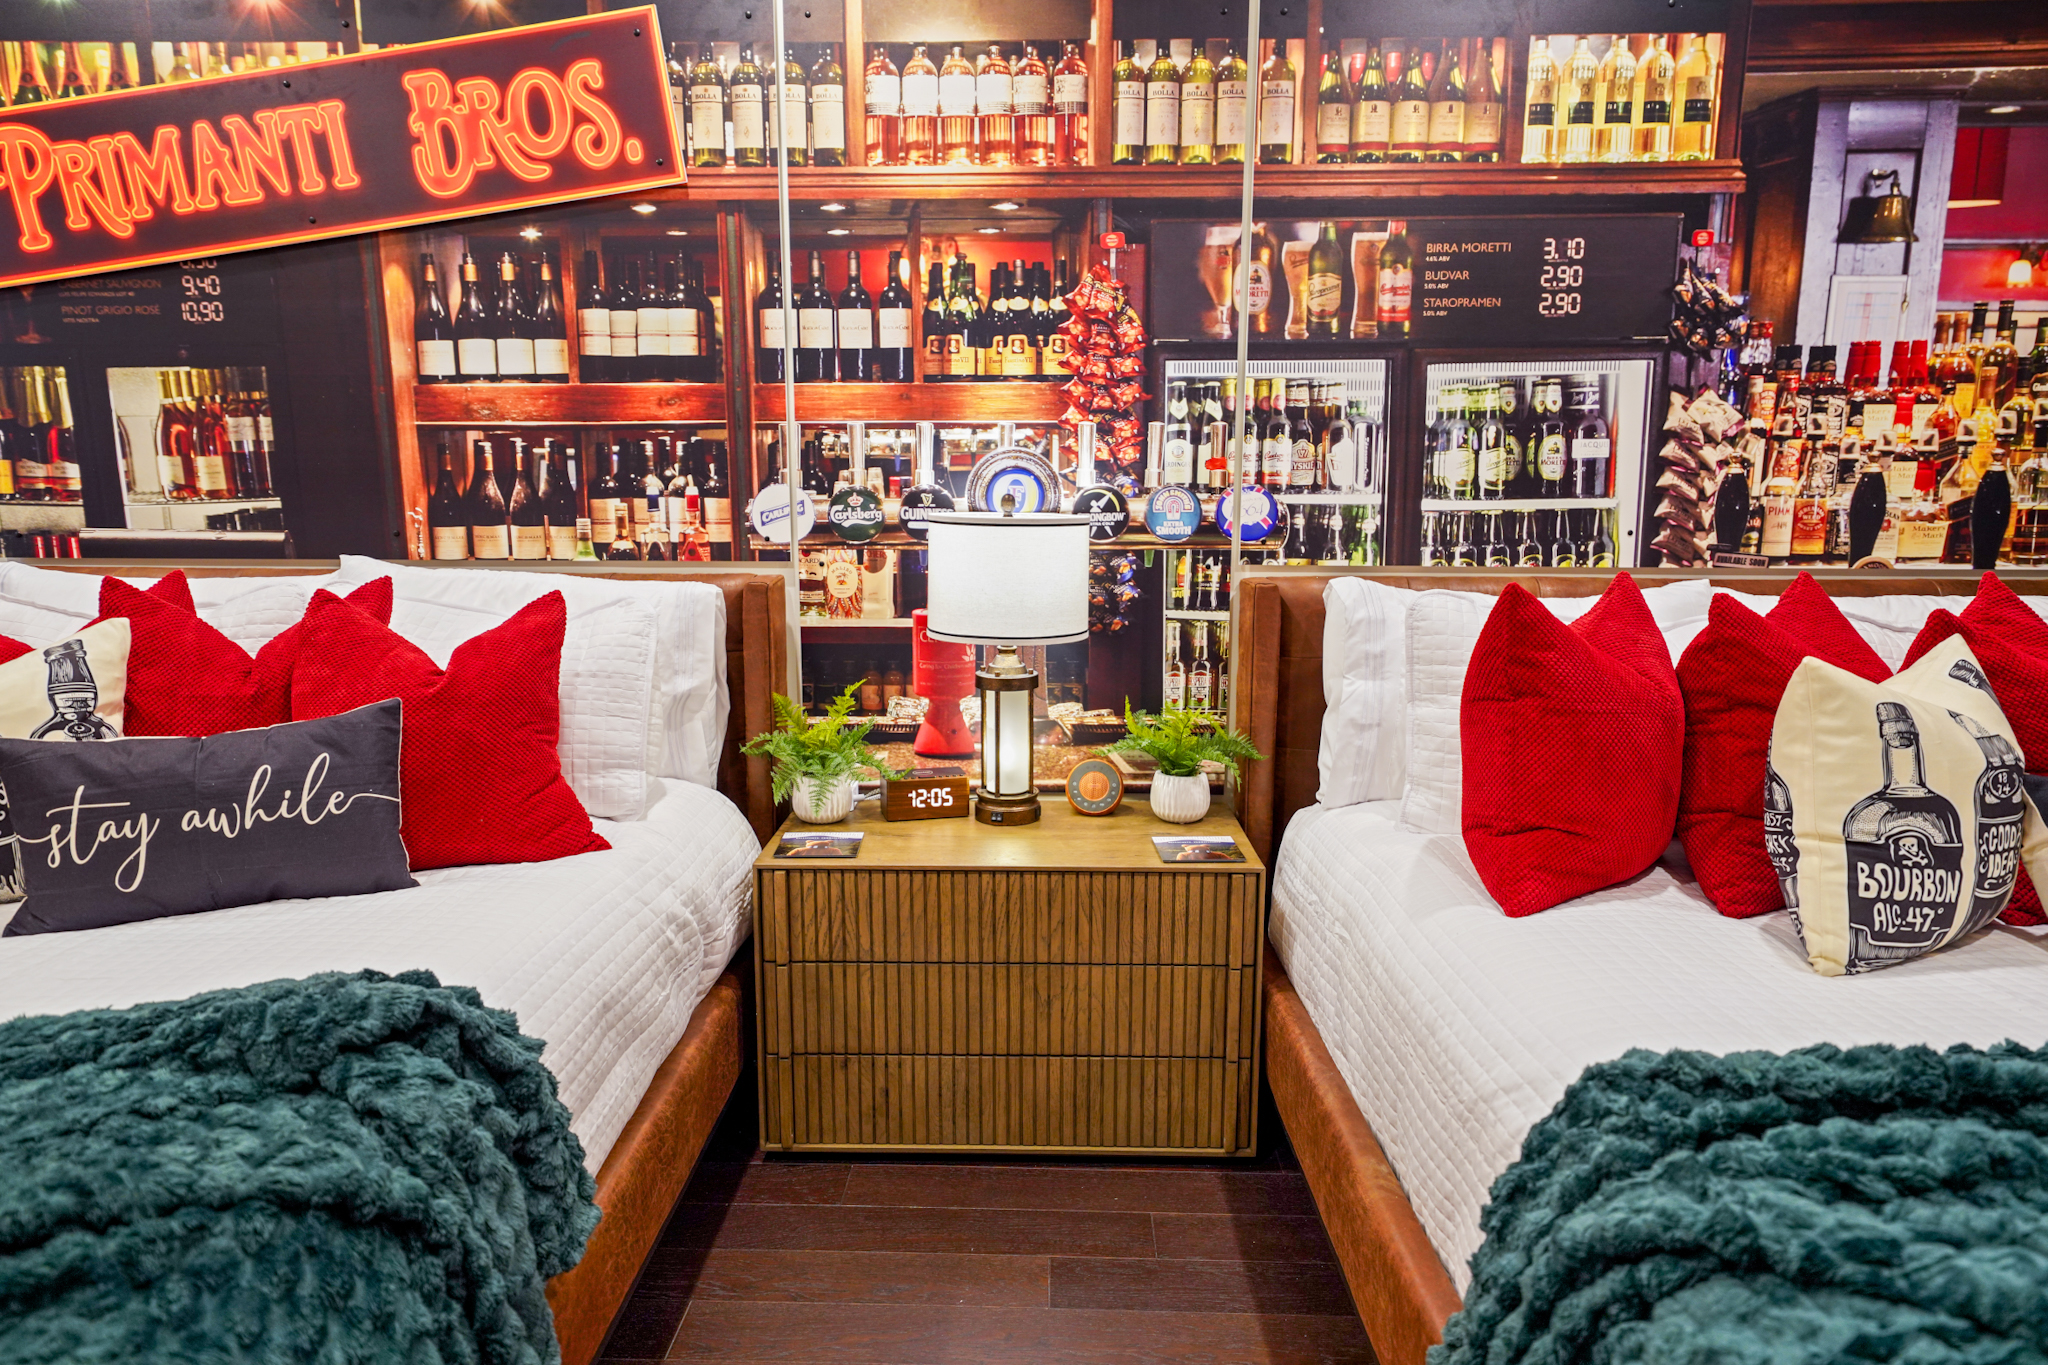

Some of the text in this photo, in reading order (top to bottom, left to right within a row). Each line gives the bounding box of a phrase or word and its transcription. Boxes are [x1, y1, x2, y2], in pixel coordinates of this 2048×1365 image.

[0, 58, 642, 252] PRIMANTI BROS.
[1426, 237, 1585, 259] BIRRA MORETTI 3.10
[181, 275, 221, 296] 9.40
[1425, 265, 1583, 287] BUDVAR 2.90
[61, 306, 92, 315] PINOT
[95, 306, 133, 315] GRIGIO
[181, 301, 224, 322] 10.90
[1423, 293, 1581, 314] STAROPRAMEN 2.90
[829, 503, 883, 526] Carlsberg
[1077, 512, 1126, 522] ONGBOW
[1155, 525, 1192, 536] SMOOTH
[1716, 555, 1767, 567] AVAILABLE SOON
[907, 787, 954, 808] 12:05
[17, 752, 400, 892] stay awhile
[1988, 824, 2017, 852] GOOD
[1987, 849, 2015, 879] IDEA
[1857, 862, 1962, 904] BOURBON
